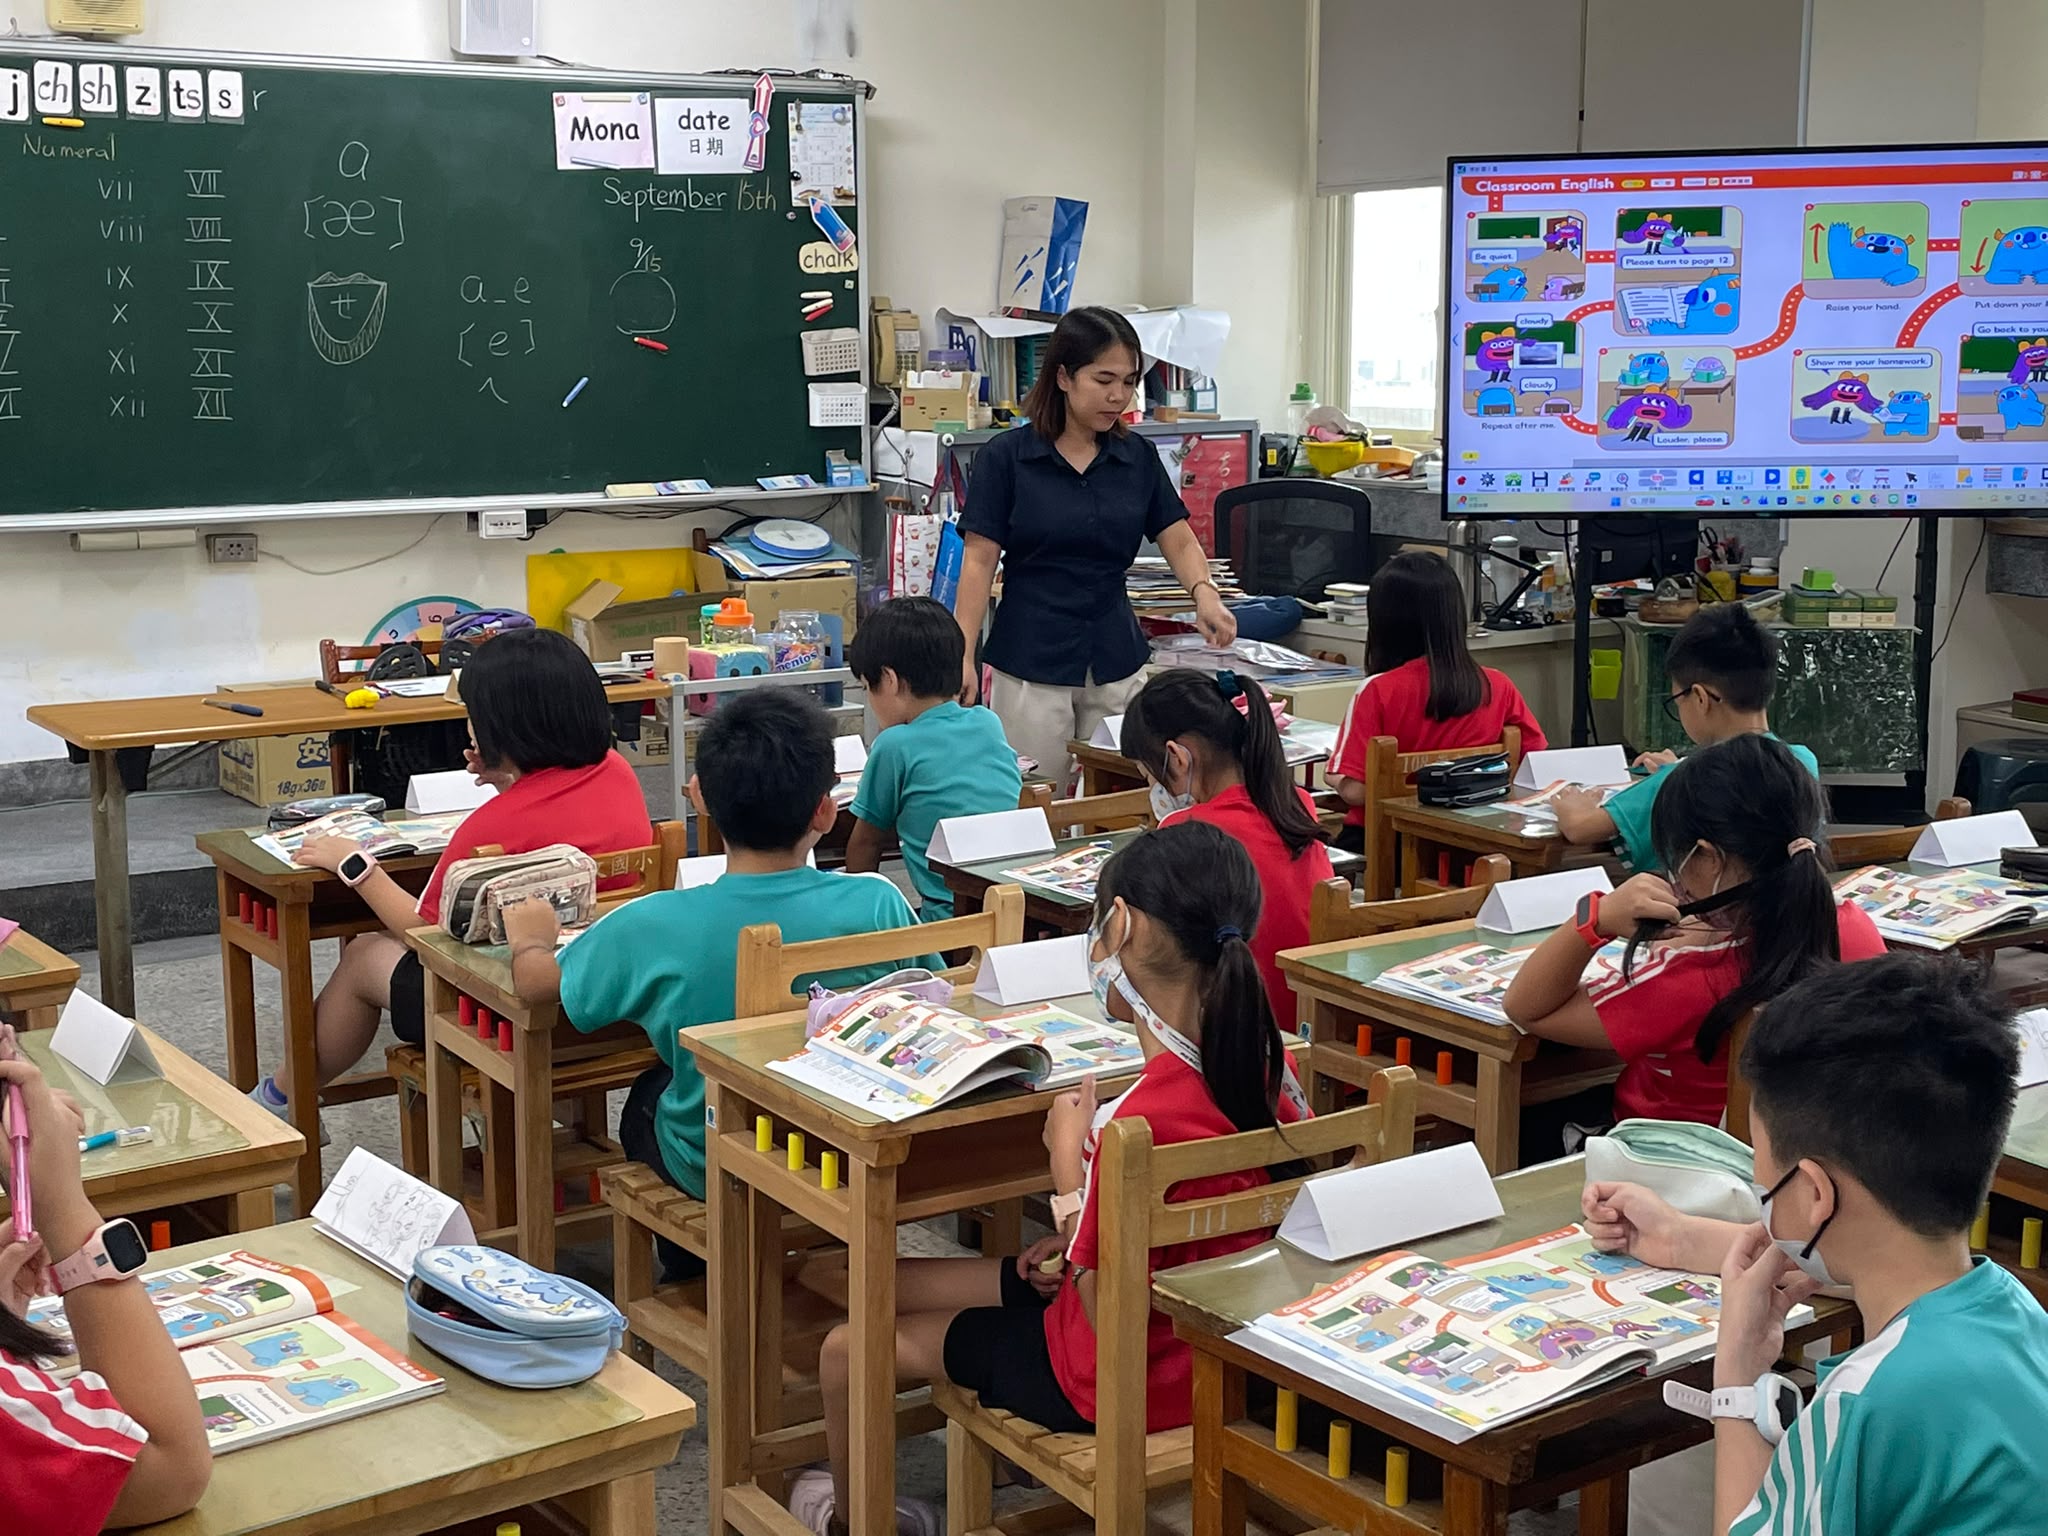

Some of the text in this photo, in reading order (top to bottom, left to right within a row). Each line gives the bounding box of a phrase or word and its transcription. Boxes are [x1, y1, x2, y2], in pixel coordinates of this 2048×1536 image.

[7, 73, 19, 116] j
[37, 66, 68, 104] ch
[81, 66, 113, 106] sh
[135, 84, 152, 107] z
[173, 80, 202, 110] ts
[218, 87, 232, 110] s
[570, 116, 640, 142] Mona
[678, 108, 731, 131] date
[22, 133, 117, 162] Numeral
[689, 137, 724, 156] 日期
[1475, 181, 1555, 192] Classroom
[1560, 178, 1615, 193] English
[603, 176, 777, 224] September 15th
[803, 247, 855, 270] chalk
